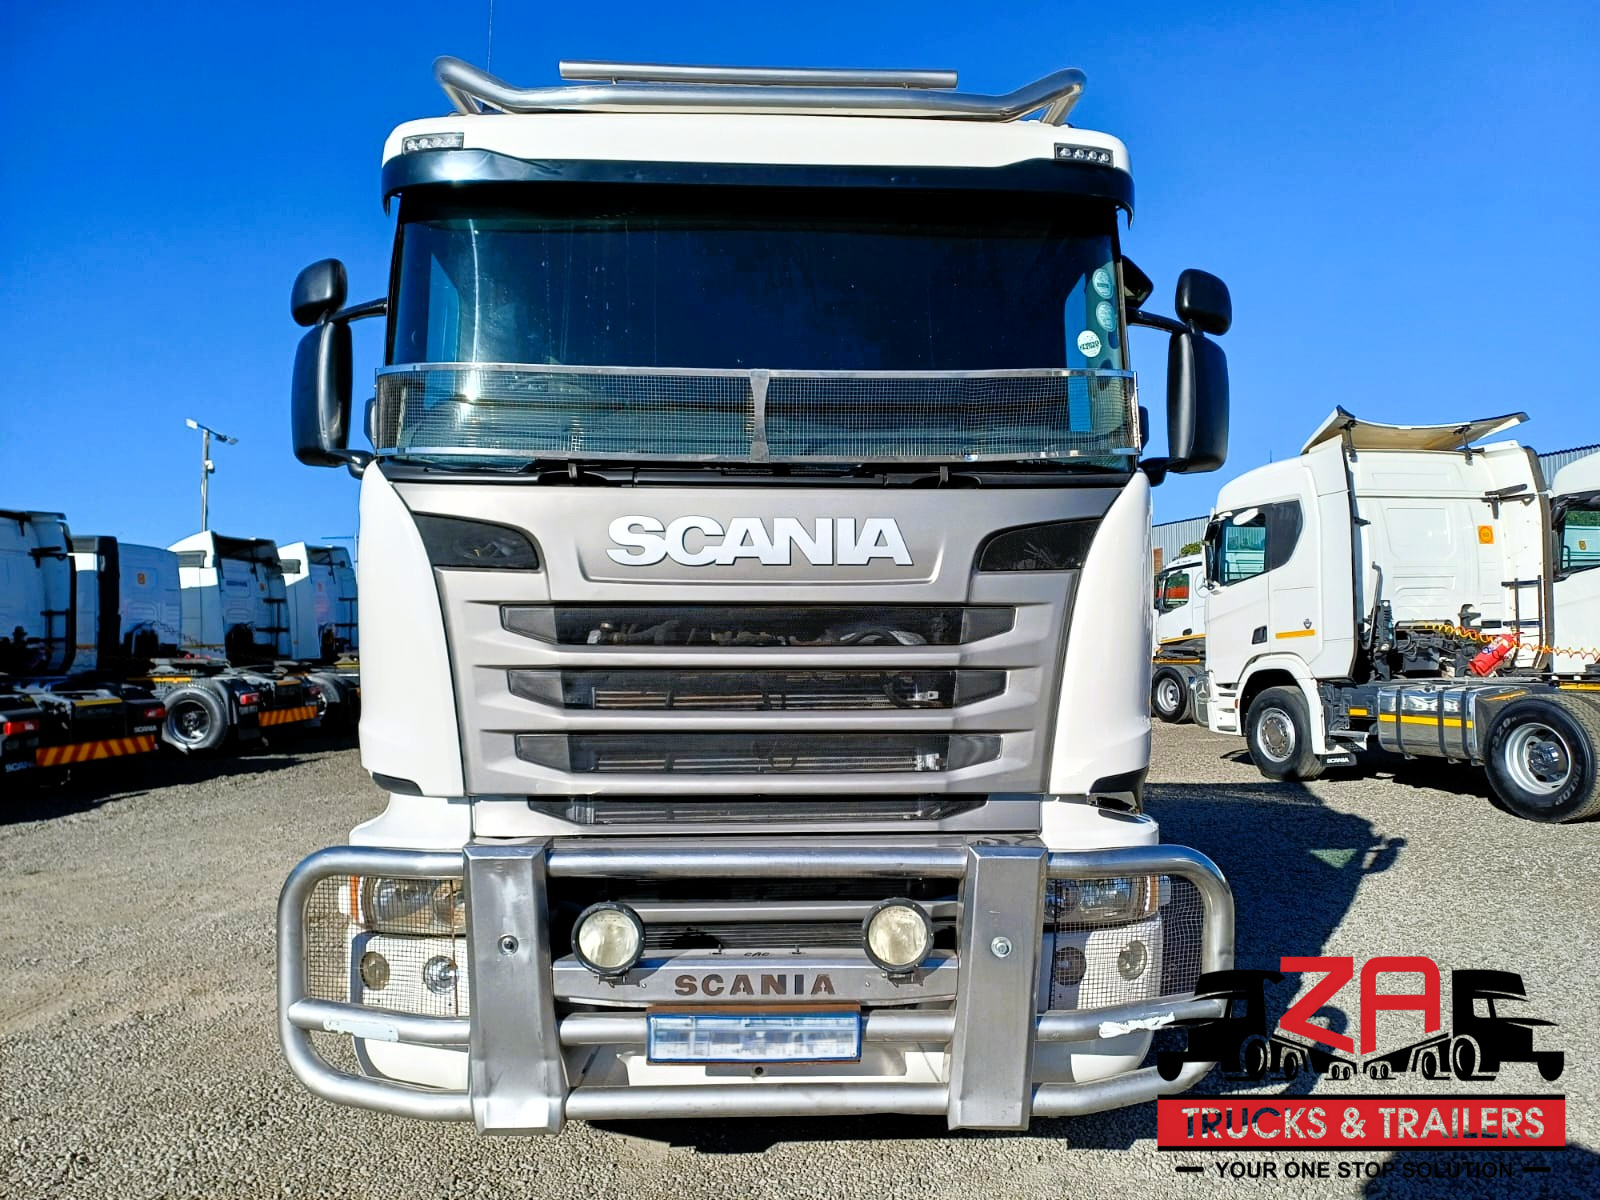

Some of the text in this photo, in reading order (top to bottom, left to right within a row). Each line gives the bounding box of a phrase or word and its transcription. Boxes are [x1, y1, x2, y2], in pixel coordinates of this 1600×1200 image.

[606, 515, 914, 567] SCANIA
[5, 761, 34, 773] SCAN
[674, 973, 836, 996] SCANIA
